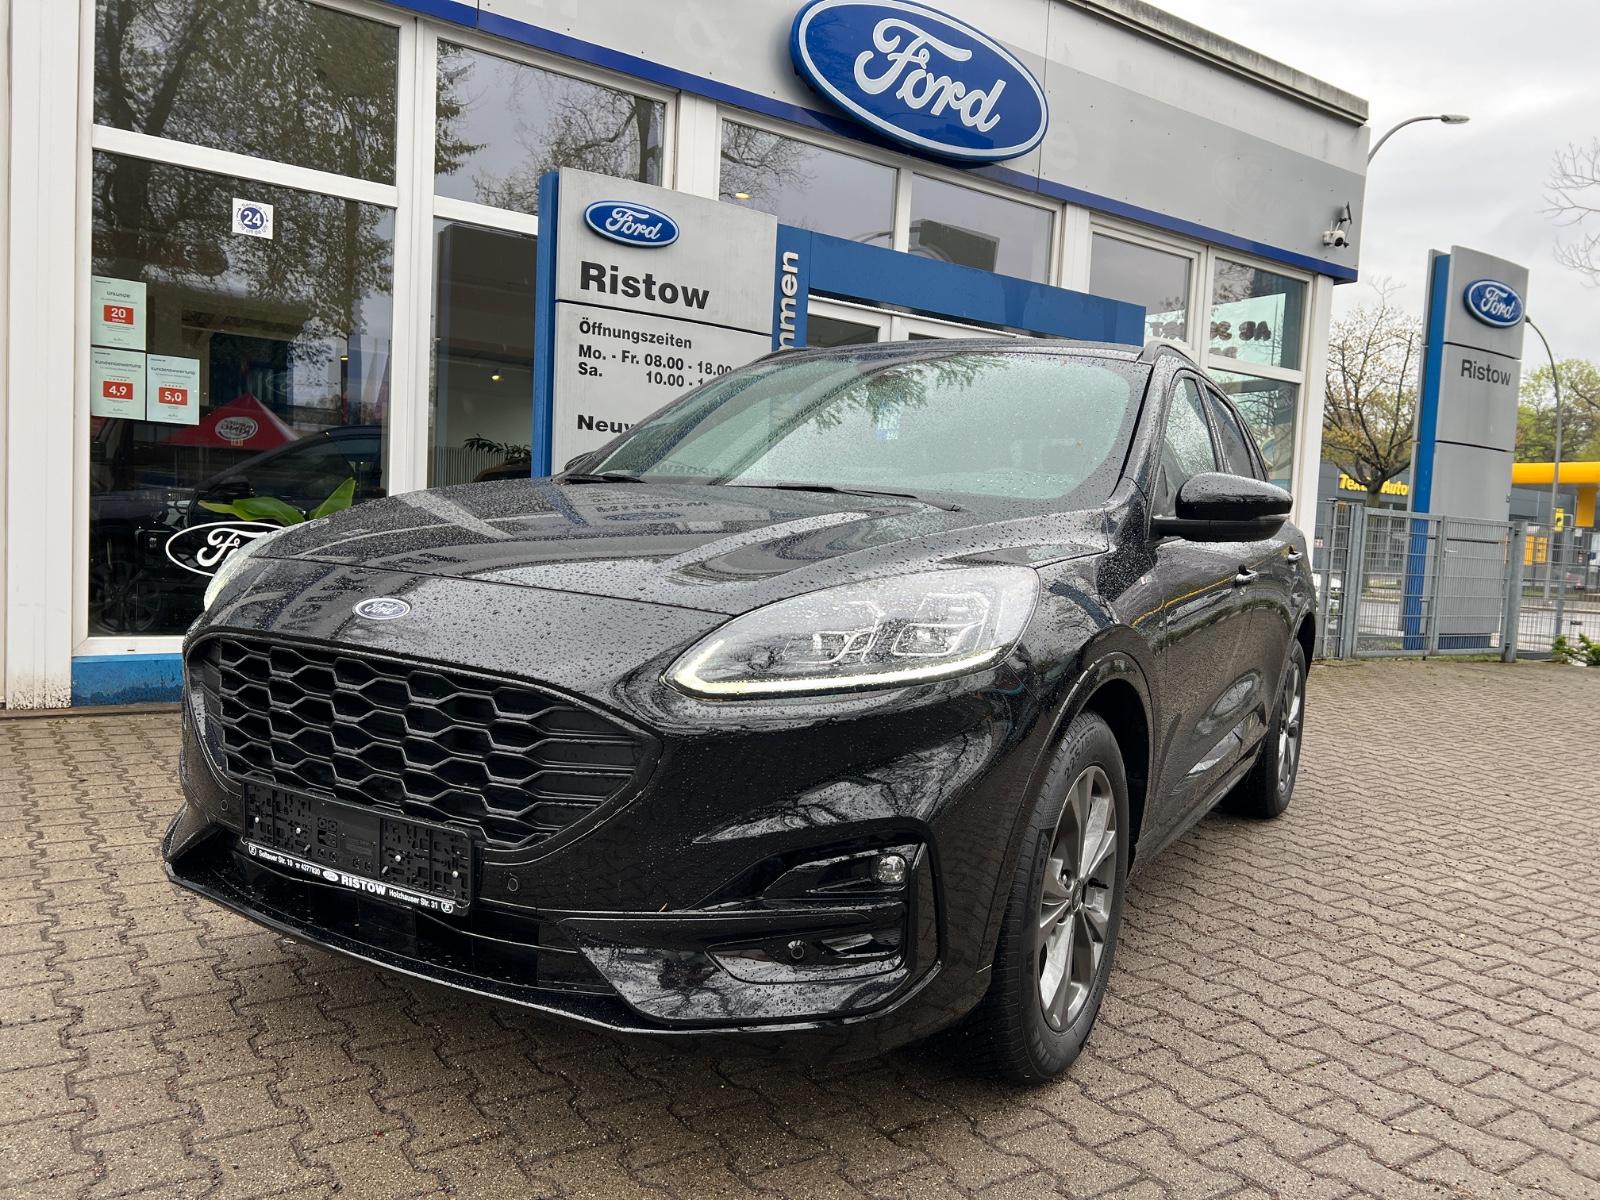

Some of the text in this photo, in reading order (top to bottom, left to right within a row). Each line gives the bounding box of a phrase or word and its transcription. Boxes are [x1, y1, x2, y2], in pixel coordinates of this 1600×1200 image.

[854, 18, 1006, 132] Ford
[243, 210, 262, 227] 24
[605, 207, 662, 240] Ford
[580, 260, 710, 310] Ristow
[111, 307, 126, 318] 20
[1480, 286, 1516, 320] Ford
[579, 317, 692, 349] Öffnungszeiten
[578, 344, 606, 360] Mo.
[621, 350, 639, 364] Fr.
[644, 354, 684, 370] 08.00
[578, 362, 603, 377] Sa.
[646, 370, 685, 387] 10.00
[1461, 358, 1511, 385] Ristow
[109, 385, 127, 396] 4,9
[164, 391, 182, 402] 5,0
[341, 875, 386, 895] RISTOW
[388, 889, 420, 904] Holzhauser
[420, 898, 430, 908] Str.
[431, 900, 438, 909] 31
